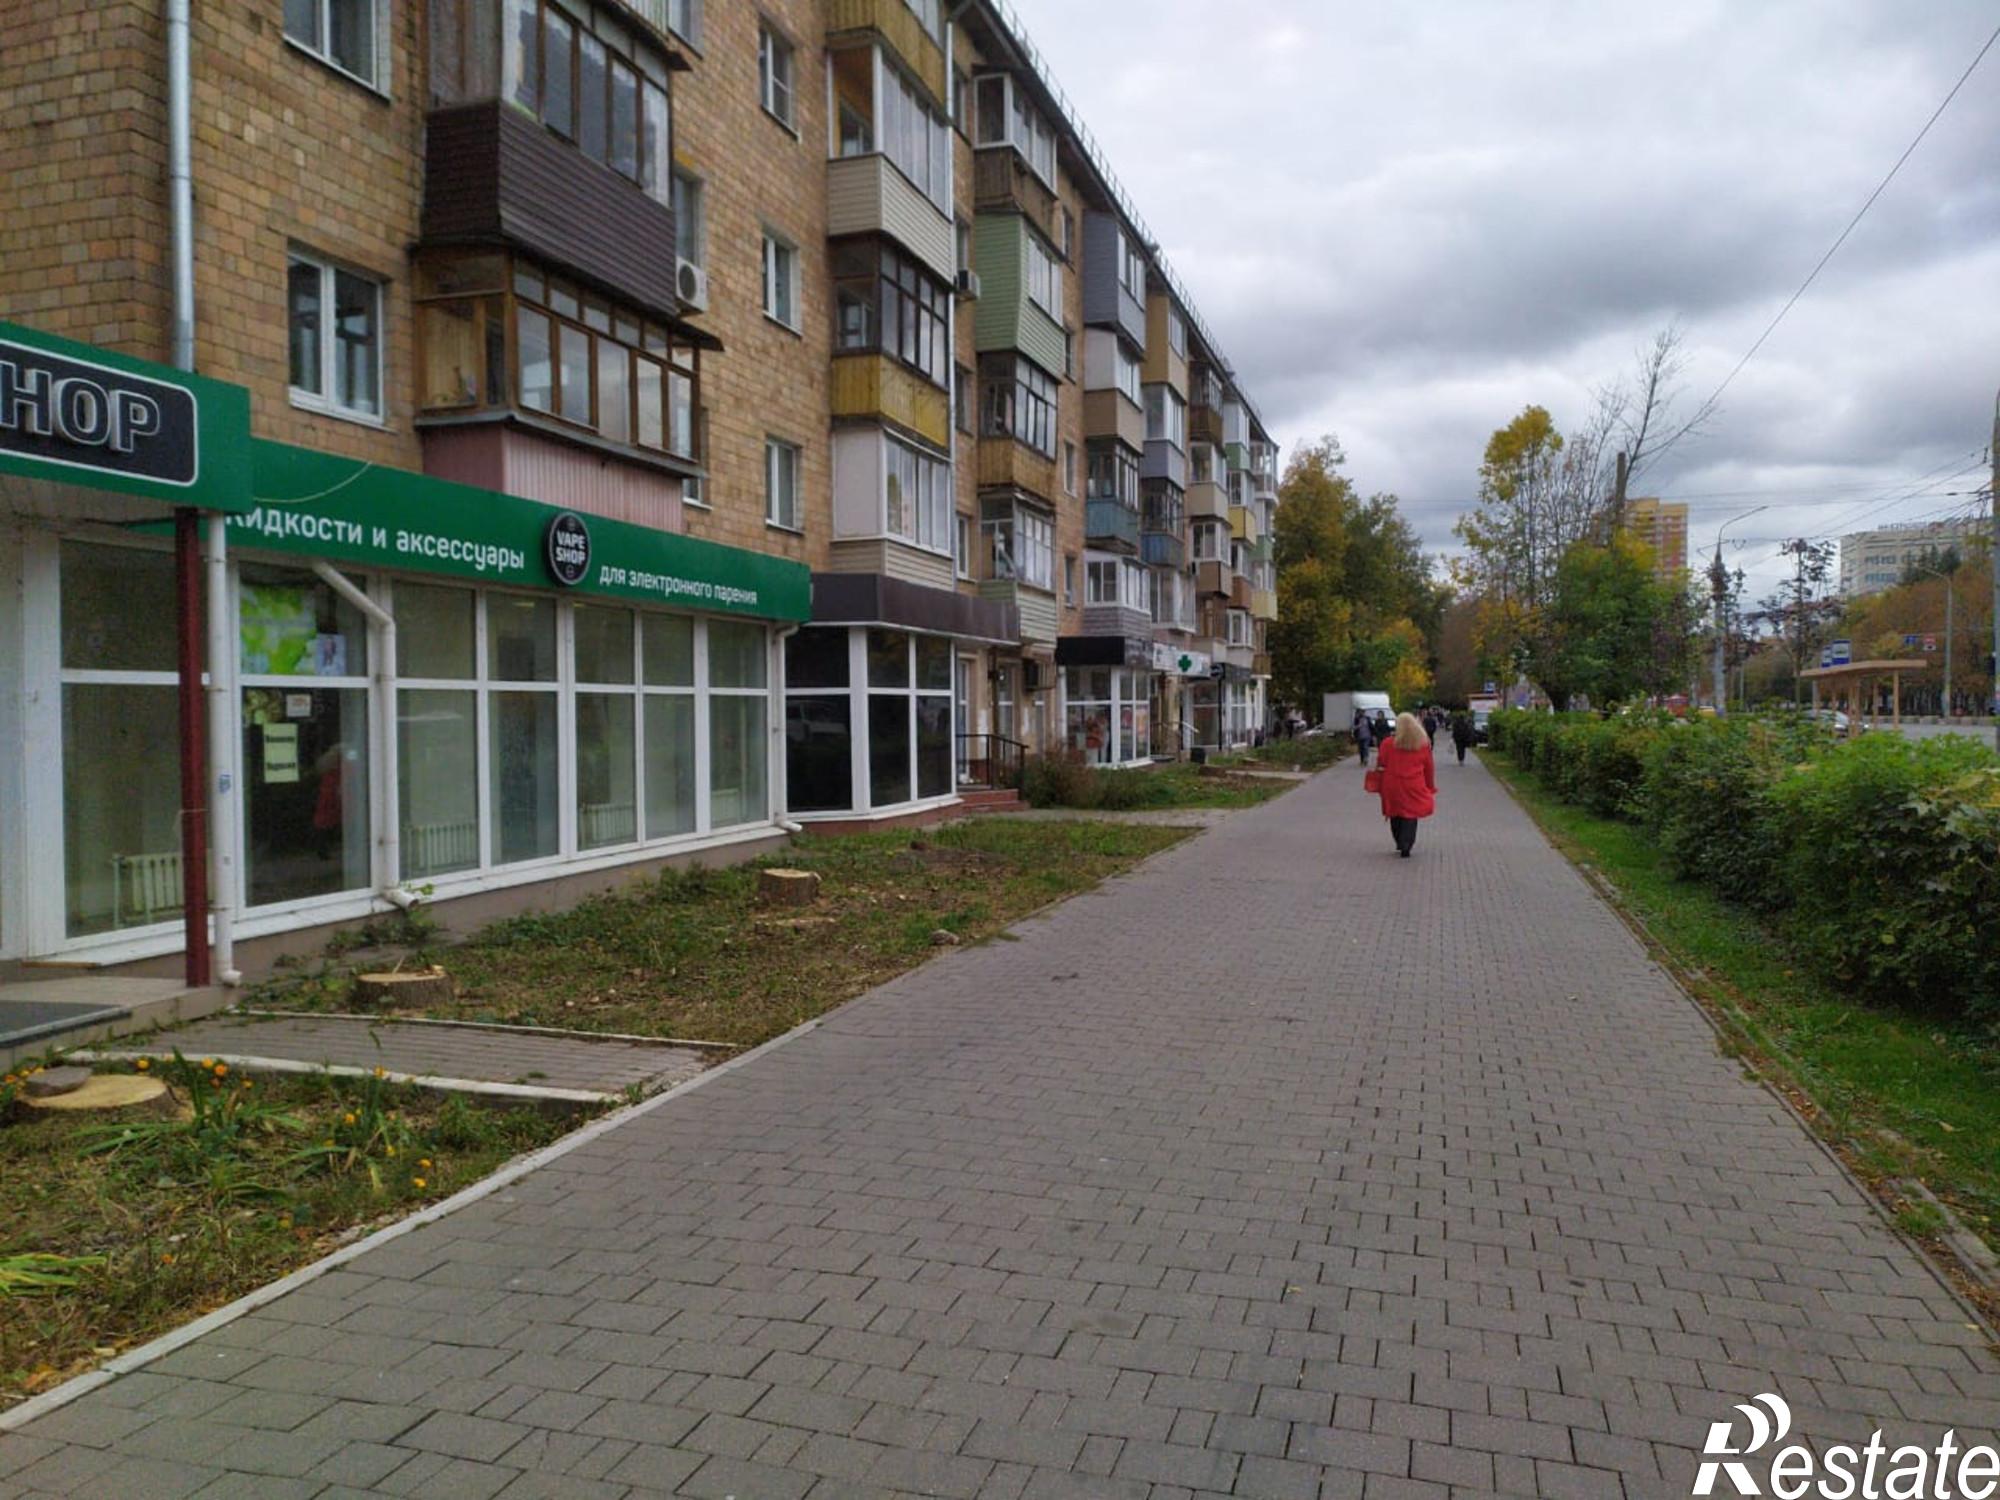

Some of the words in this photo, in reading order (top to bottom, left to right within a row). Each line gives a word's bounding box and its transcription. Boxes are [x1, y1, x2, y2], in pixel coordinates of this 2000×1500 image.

[372, 527, 388, 549] и
[396, 530, 526, 572] аксессуары
[556, 530, 586, 549] VAPE
[556, 547, 586, 566] SHOP
[600, 565, 626, 586] для
[628, 570, 713, 597] электронного
[714, 585, 758, 606] парения
